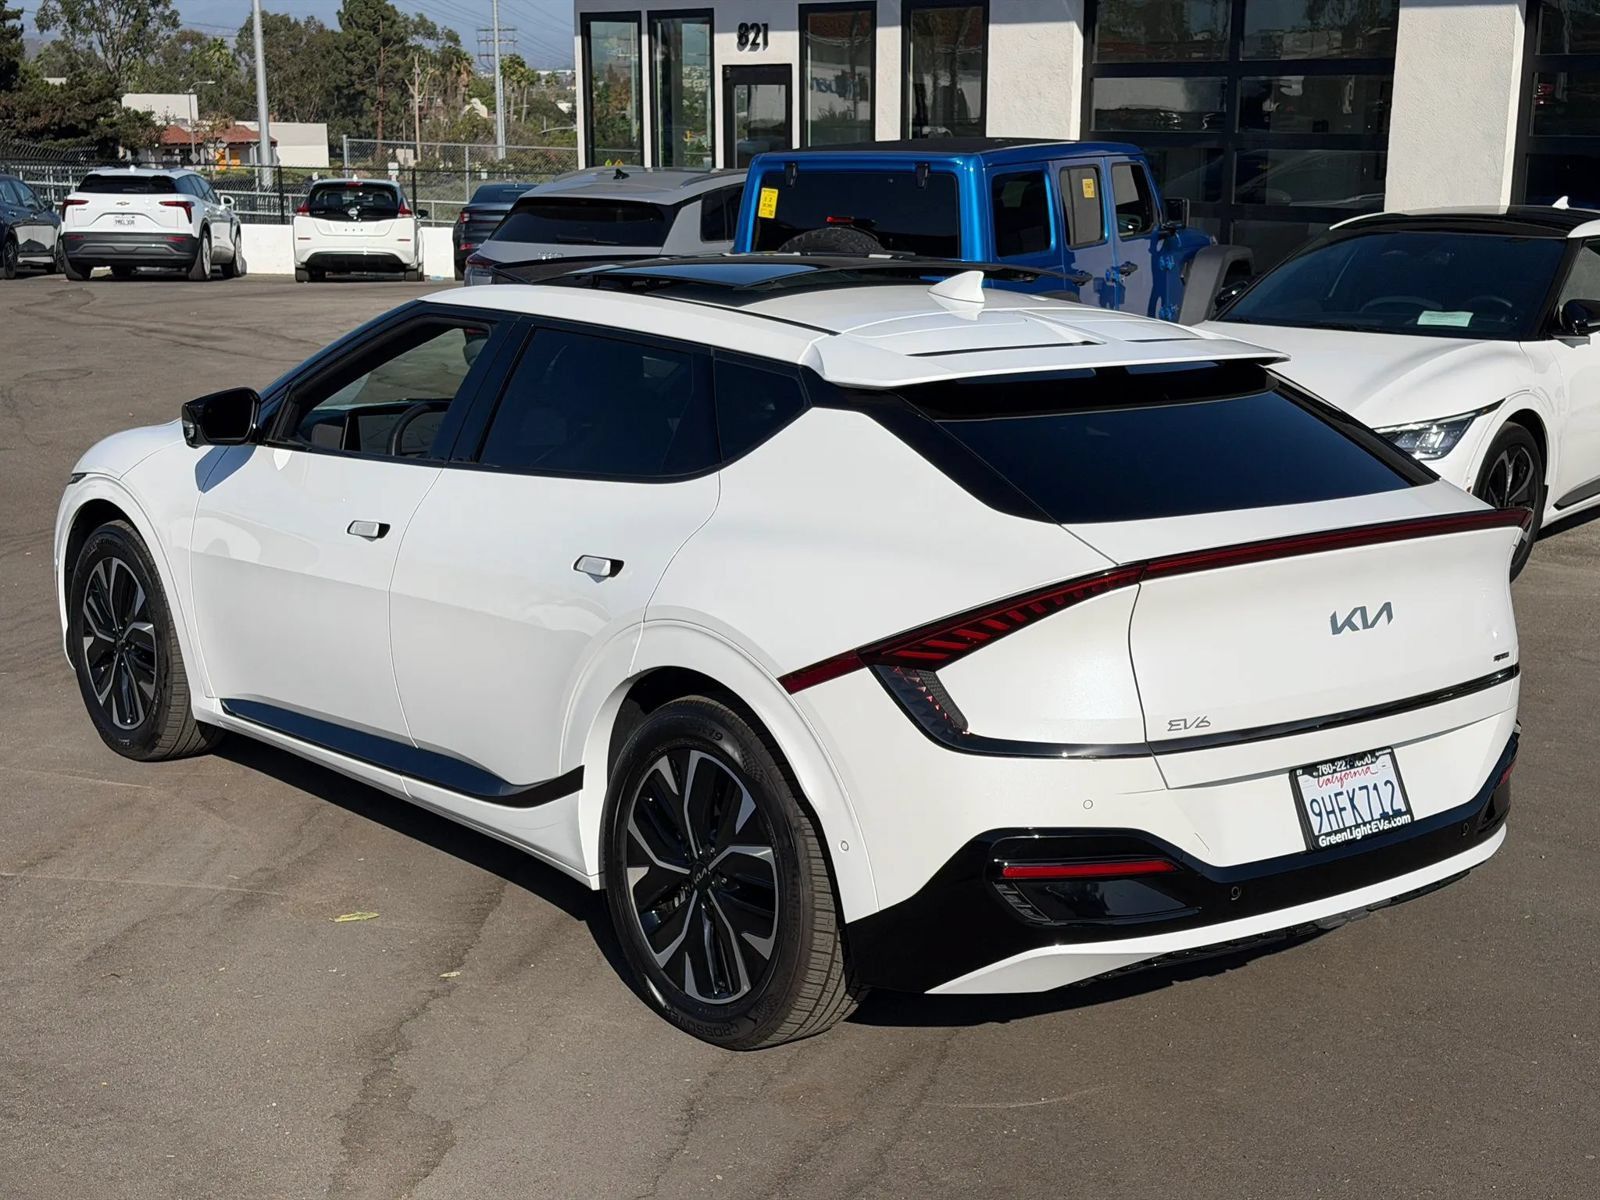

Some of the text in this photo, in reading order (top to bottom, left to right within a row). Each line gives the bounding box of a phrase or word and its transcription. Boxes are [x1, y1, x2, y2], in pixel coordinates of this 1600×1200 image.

[738, 22, 769, 47] 821
[1330, 601, 1394, 636] KIA
[1167, 715, 1211, 732] EV6
[1316, 765, 1378, 789] California
[1309, 779, 1402, 834] 9HFK712
[1318, 814, 1411, 848] GreenLightEVs.com
